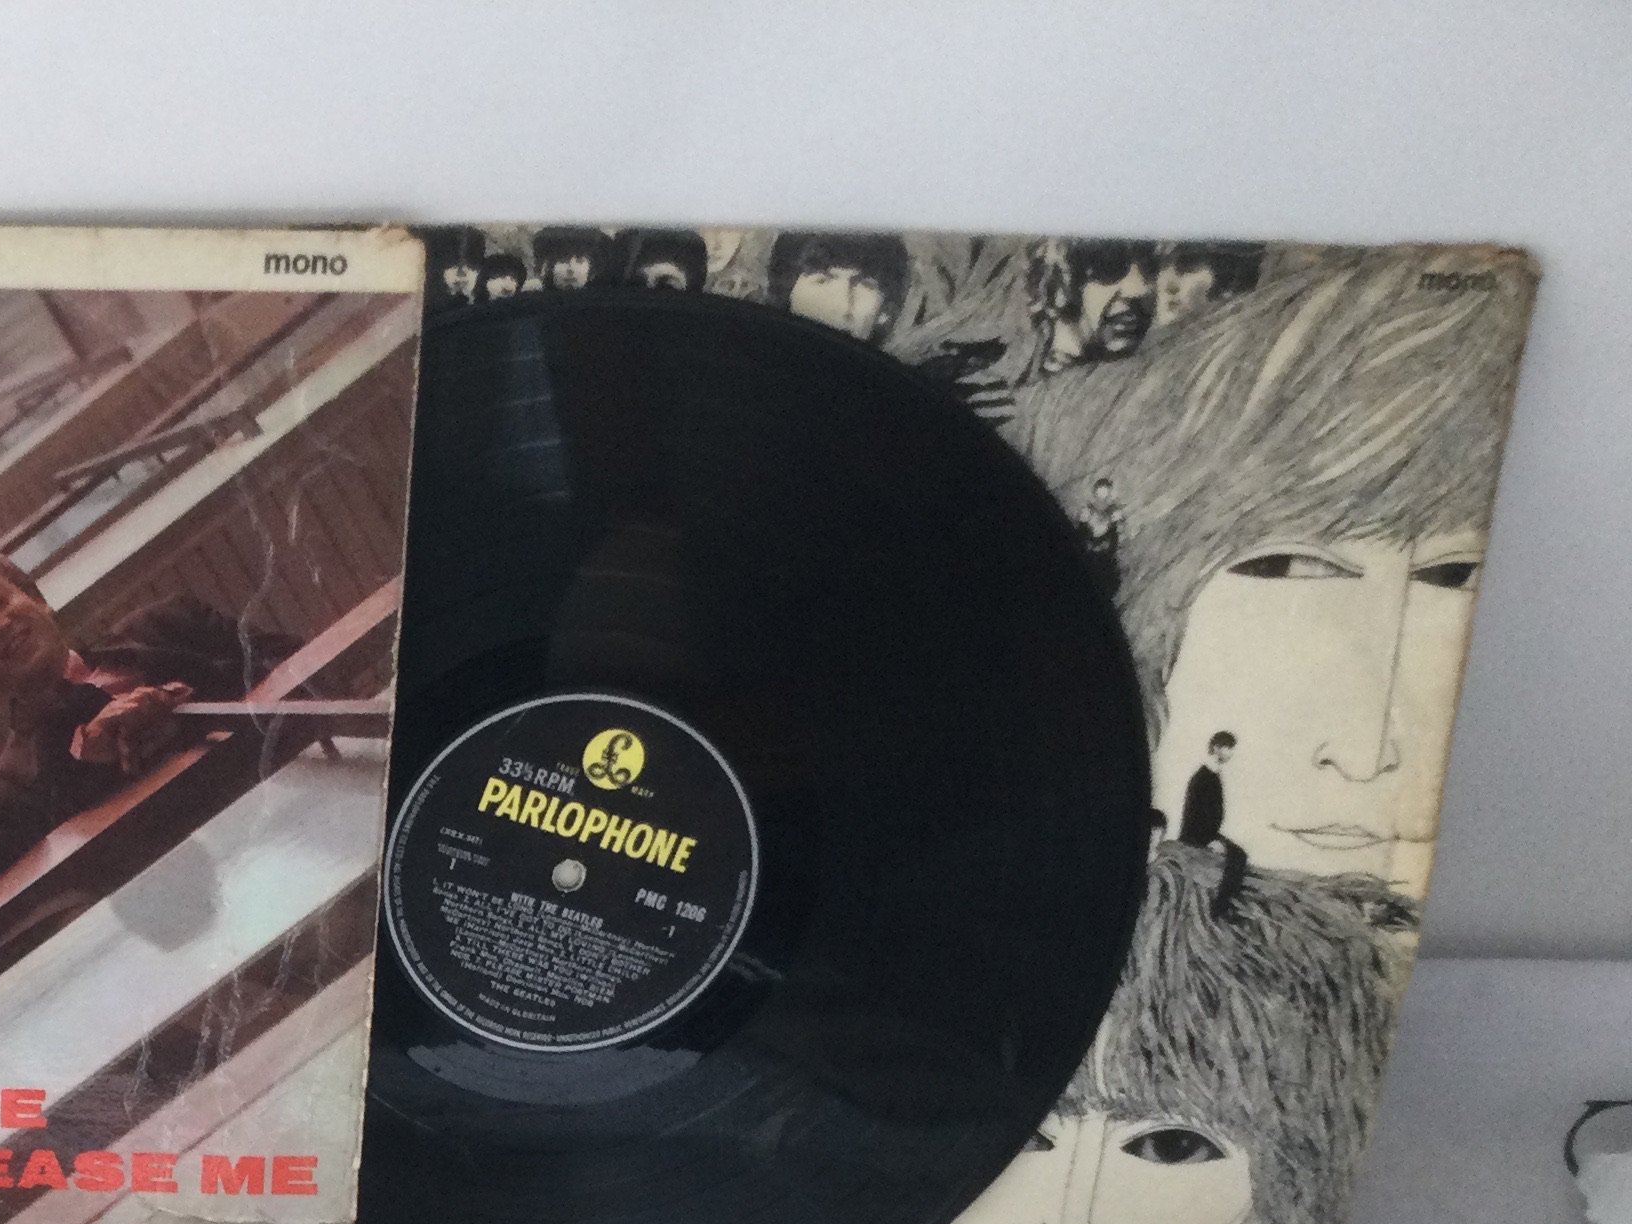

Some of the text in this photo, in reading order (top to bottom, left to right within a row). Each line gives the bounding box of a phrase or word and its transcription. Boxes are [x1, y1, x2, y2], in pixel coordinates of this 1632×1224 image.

[263, 251, 349, 277] mono
[478, 777, 696, 873] PARLOPHONE
[634, 886, 668, 911] PMC
[539, 900, 558, 915] THE
[560, 907, 604, 930] BEATLES
[200, 1154, 319, 1196] ME
